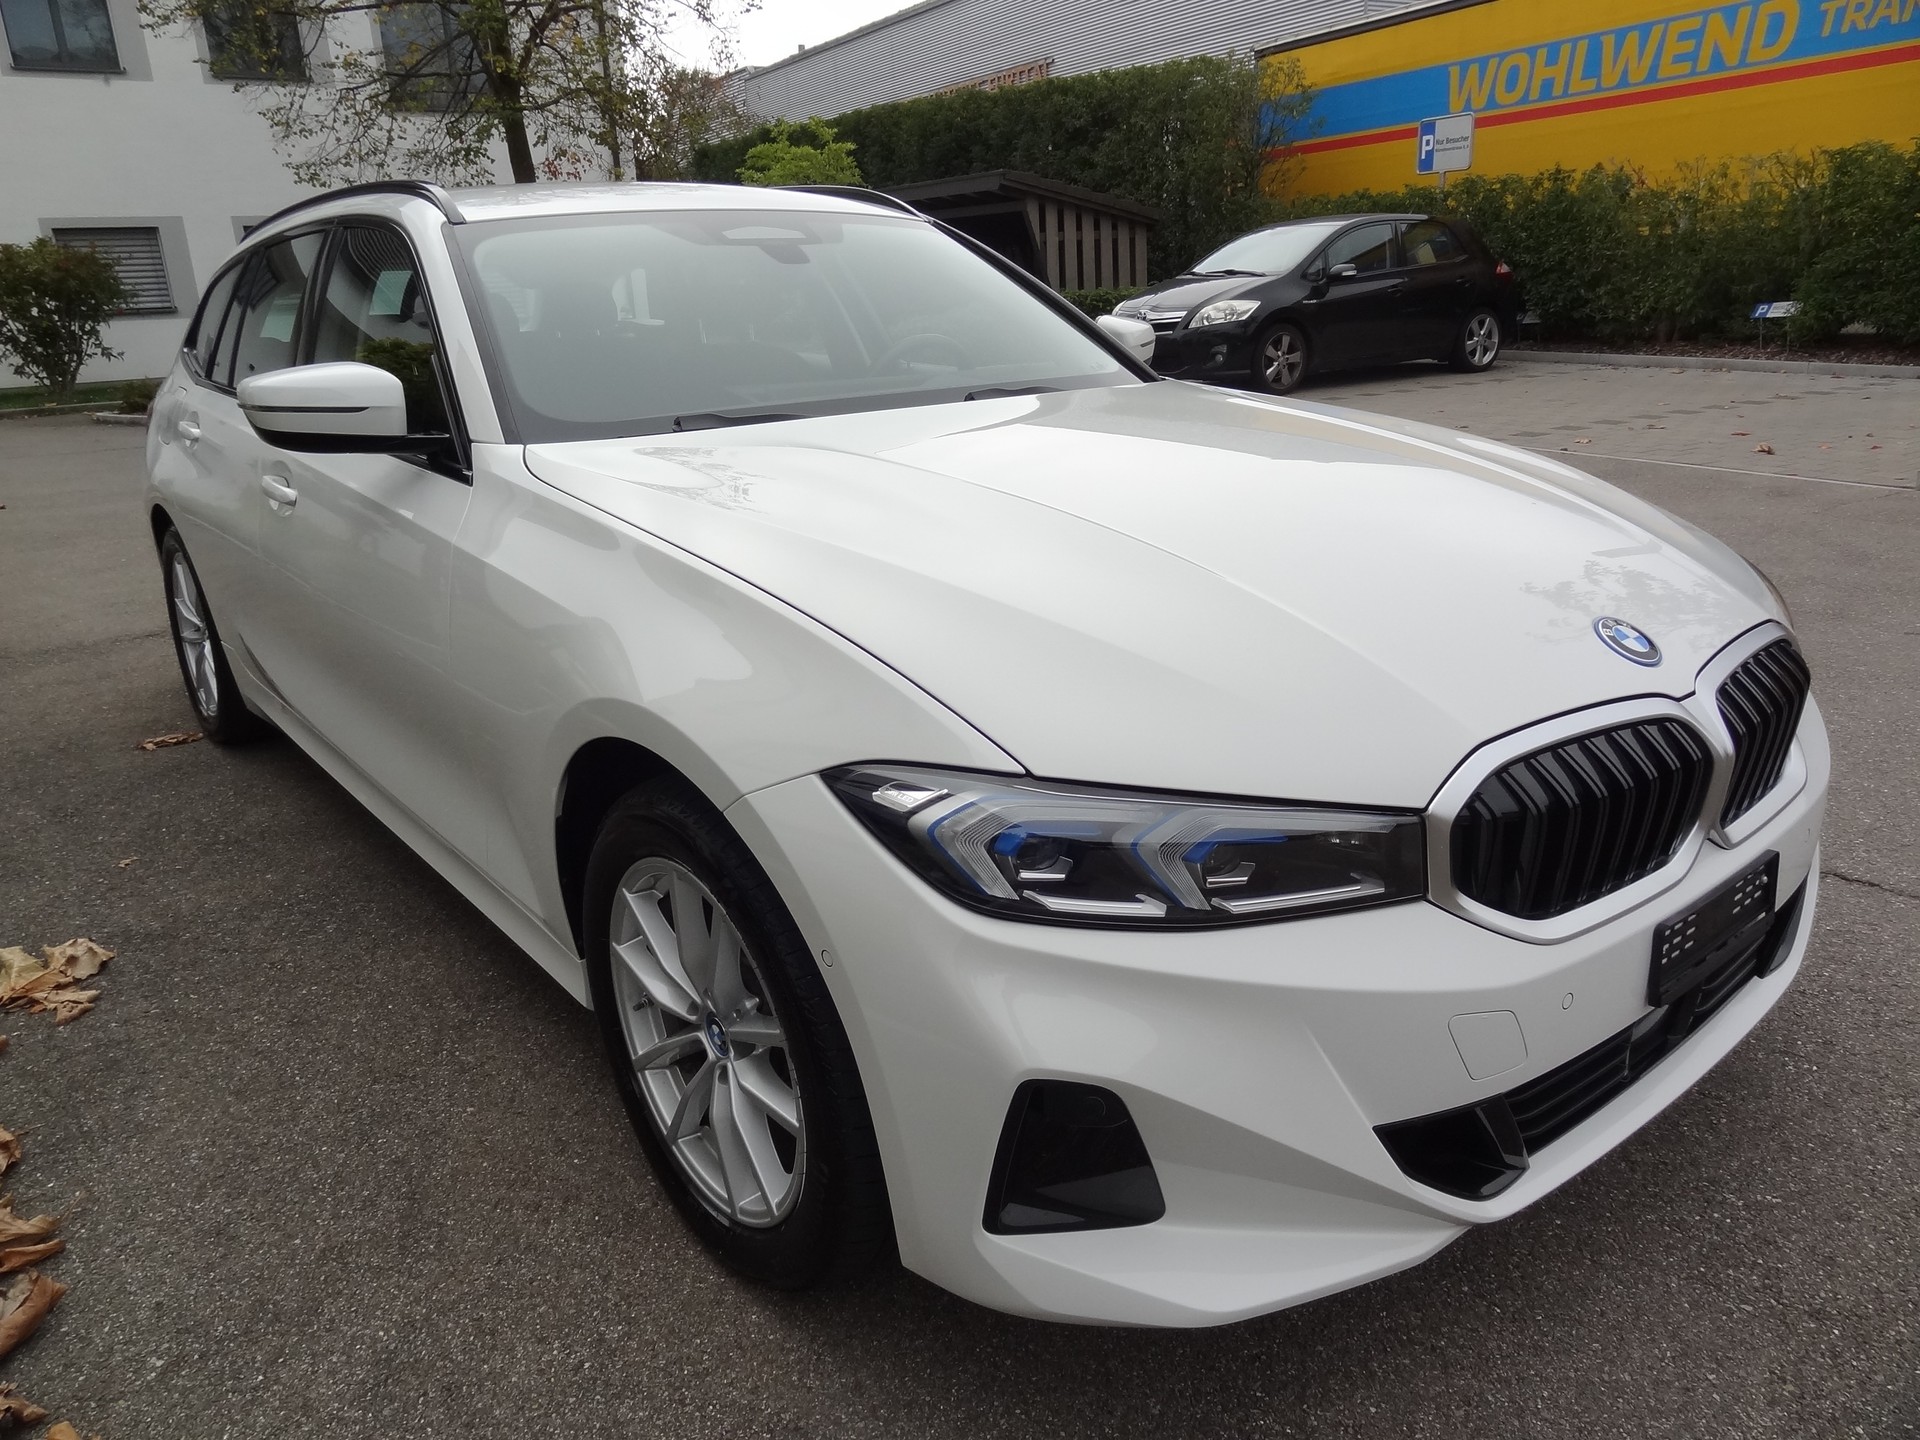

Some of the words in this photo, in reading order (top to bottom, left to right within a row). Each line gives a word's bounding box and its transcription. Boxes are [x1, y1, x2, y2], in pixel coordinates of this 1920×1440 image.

[1448, 0, 1800, 113] WOHLWEND
[1421, 135, 1434, 159] P
[1755, 305, 1768, 317] P
[898, 793, 914, 803] LED
